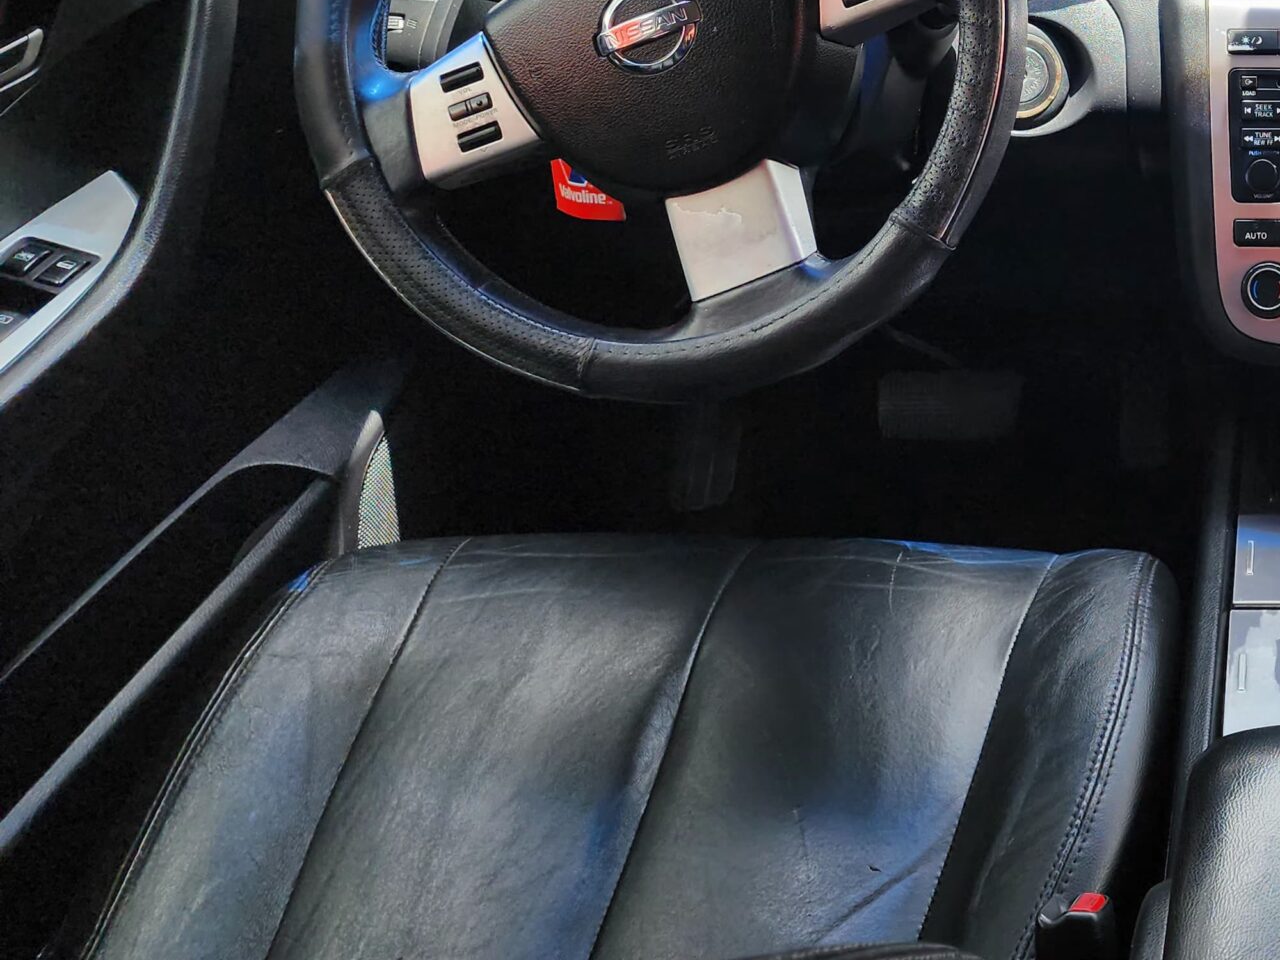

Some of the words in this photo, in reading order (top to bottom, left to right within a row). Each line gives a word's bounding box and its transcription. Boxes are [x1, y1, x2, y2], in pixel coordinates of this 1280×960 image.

[604, 7, 689, 50] NISSAN
[1255, 103, 1273, 111] SEEK
[1254, 131, 1273, 139] TUNE
[558, 183, 607, 205] Valvoline
[1244, 231, 1268, 240] AUTO
